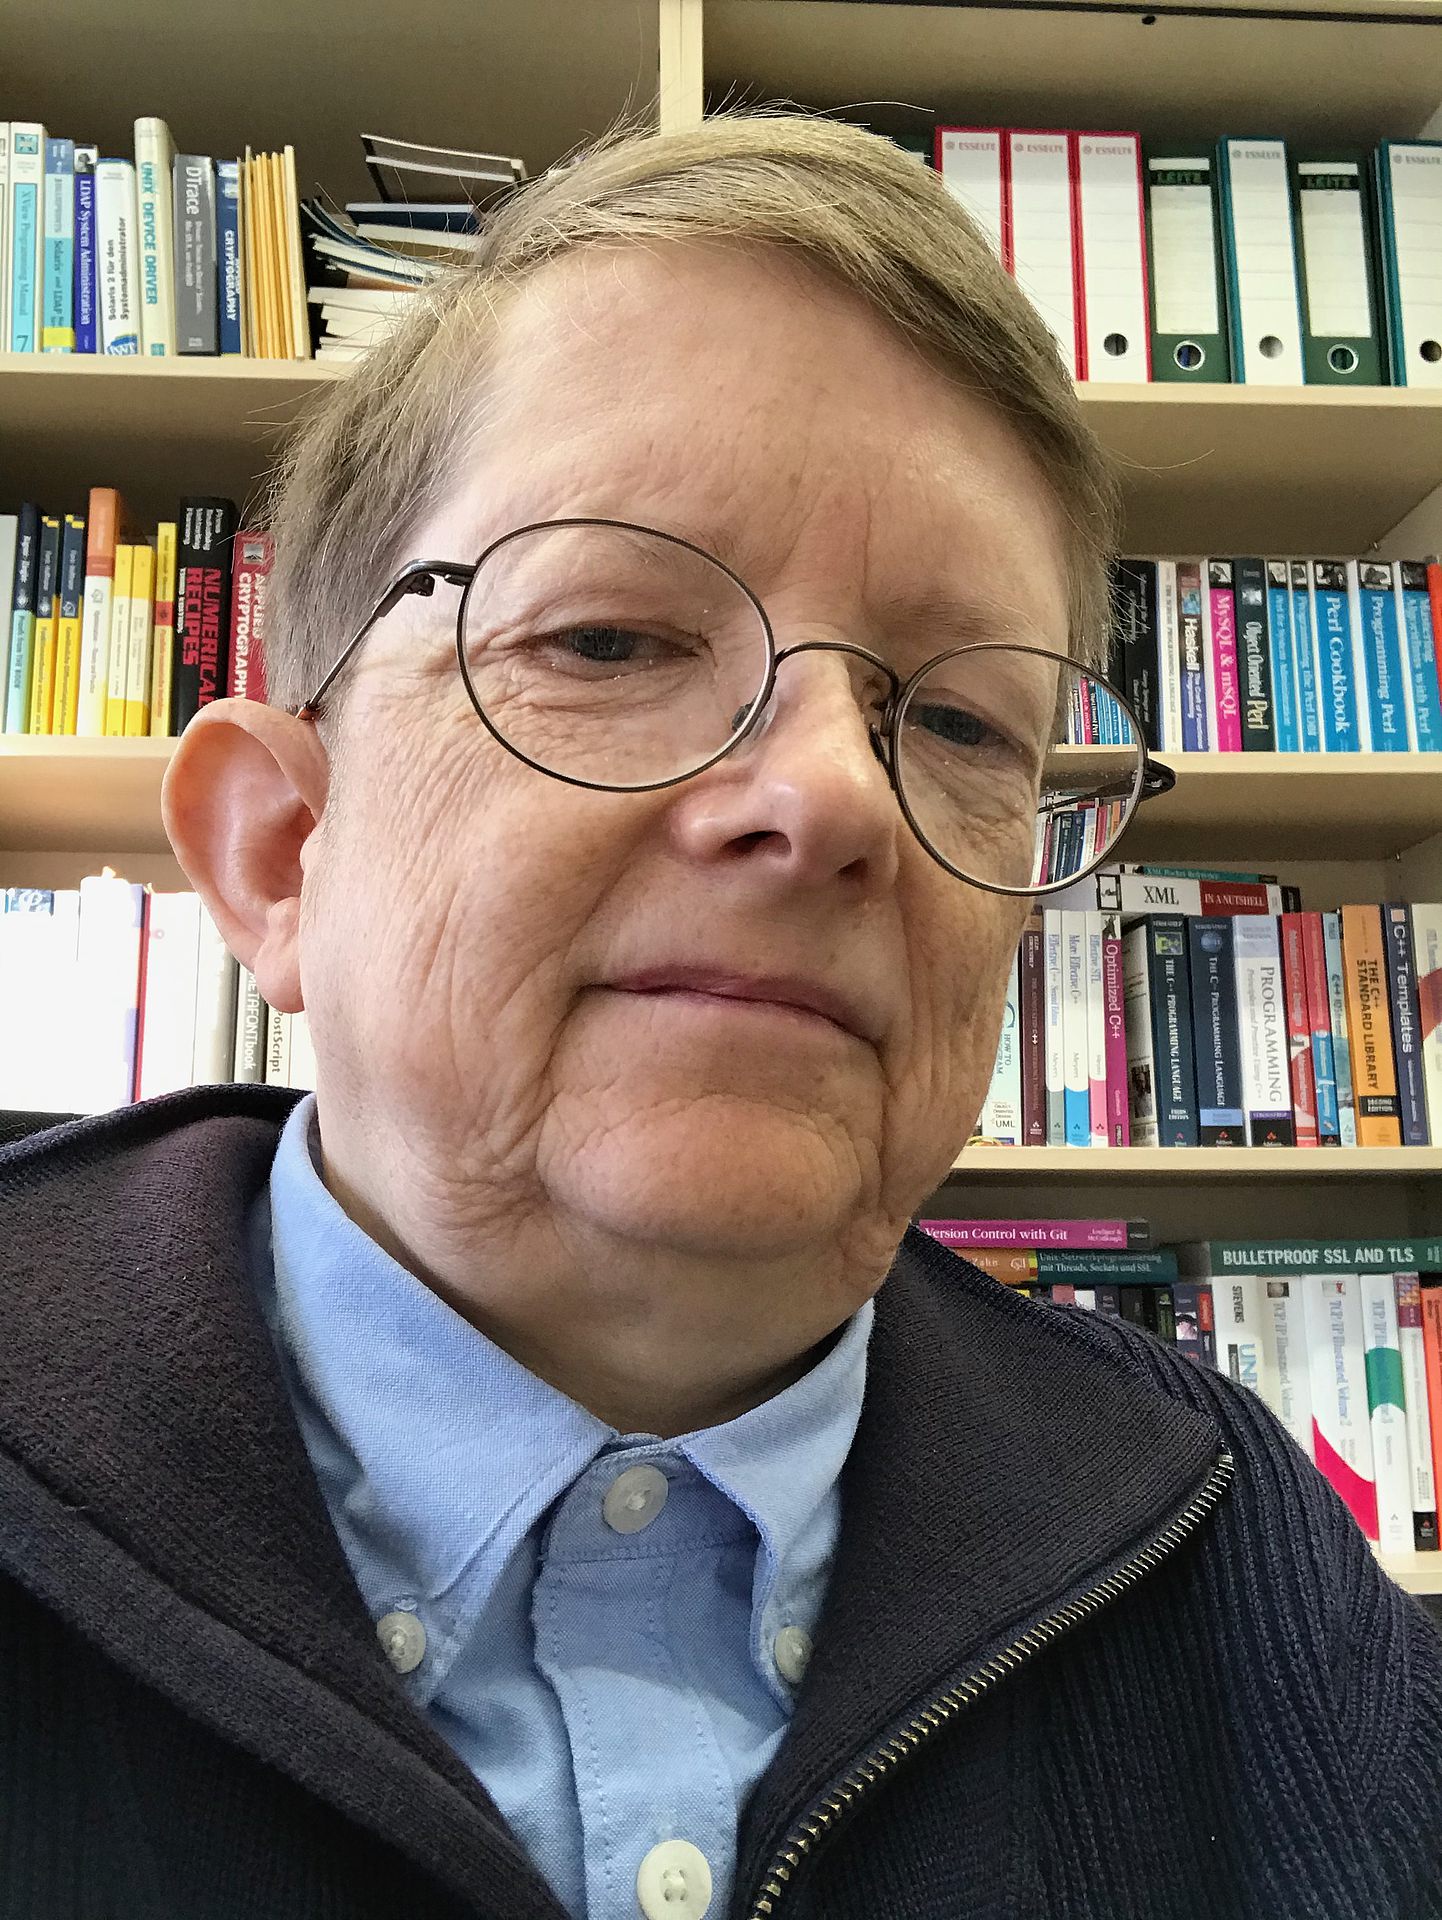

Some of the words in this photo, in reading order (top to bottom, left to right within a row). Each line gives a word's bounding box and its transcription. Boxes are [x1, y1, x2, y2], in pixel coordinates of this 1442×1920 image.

[958, 142, 996, 151] ESSELTE
[1026, 144, 1064, 154] ESSELTE
[1095, 146, 1132, 156] ESSELTE
[1244, 150, 1280, 160] ESSELTE
[1404, 155, 1440, 165] ESSELTE
[141, 162, 153, 194] UNIX
[186, 166, 202, 215] DTrace
[1157, 171, 1201, 185] LEITZ
[1305, 175, 1350, 188] LEITZ
[80, 180, 91, 208] LDAP
[79, 210, 90, 247] System
[143, 201, 156, 251] DEVICE
[54, 240, 63, 271] Solaris
[106, 261, 116, 275] für
[119, 217, 130, 320] Systemadministrator
[80, 248, 91, 325] Administration
[145, 255, 157, 305] DRIVER
[224, 230, 236, 321] CRYPTOGRAPHY
[19, 282, 29, 316] Manual
[53, 290, 62, 314] LDAP
[108, 286, 116, 321] Solaris
[17, 335, 29, 352] 7
[182, 567, 204, 665] RECIPES
[1214, 594, 1232, 650] MySQL
[1326, 597, 1343, 632] Perl
[198, 568, 222, 708] NUMERICAL
[233, 572, 253, 699] CRYPTOGRAPHY
[1184, 618, 1200, 672] Haskell
[1243, 621, 1263, 654] Object
[1371, 597, 1390, 700] Programming
[1220, 654, 1234, 667] &
[1246, 654, 1265, 698] Oriented
[1303, 670, 1312, 687] the
[1329, 637, 1350, 734] Cookbook
[1415, 672, 1427, 703] with
[1187, 672, 1195, 719] Programming
[1219, 671, 1237, 720] mSQL
[1304, 690, 1315, 712] Perl
[1247, 700, 1269, 730] Perl
[1380, 704, 1396, 734] Perl
[1417, 707, 1431, 734] Perl
[1142, 886, 1180, 906] XML
[1204, 893, 1214, 903] IN
[1215, 895, 1222, 904] A
[1223, 894, 1266, 907] NUTSHELL
[1048, 934, 1059, 967] Effective
[1069, 934, 1079, 955] More
[1089, 934, 1100, 967] Effective
[1393, 924, 1406, 957] C++
[1050, 968, 1060, 983] C++
[1069, 956, 1081, 989] Effective
[1090, 968, 1101, 984] STL
[1104, 943, 1121, 1012] Optimized
[1165, 959, 1175, 977] THE
[1208, 957, 1218, 974] THE
[1291, 970, 1300, 990] C++
[1368, 960, 1379, 983] THE
[1071, 990, 1081, 1005] C++
[1166, 977, 1175, 992] C++
[1331, 974, 1341, 996] C++
[1357, 959, 1373, 1031] STANDARD
[1369, 986, 1380, 1009] C++
[244, 972, 260, 1070] METAFONTbook
[1249, 1008, 1258, 1024] and
[1396, 962, 1413, 1053] Templates
[1108, 1014, 1121, 1039] C++
[1166, 993, 1178, 1058] PROGRAMMING
[1210, 991, 1223, 1059] PROGRAMMING
[1260, 966, 1282, 1103] PROGRAMMING
[269, 1011, 284, 1073] PostScript
[1004, 1034, 1012, 1051] HOW
[1250, 1025, 1261, 1057] Practice
[1004, 1054, 1012, 1067] TO
[1071, 1051, 1079, 1079] Meyers
[1364, 1033, 1378, 1090] LIBRARY
[1170, 1058, 1181, 1103] LANGUAGE
[1214, 1060, 1225, 1106] LANGUAGE
[995, 1120, 1016, 1128] UML
[924, 1227, 969, 1239] Version
[971, 1228, 1016, 1240] Control
[1019, 1228, 1047, 1240] with
[1049, 1229, 1068, 1241] Git
[1040, 1264, 1053, 1272] mit
[1055, 1263, 1089, 1273] Threads,
[1089, 1264, 1119, 1272] Sockets
[1120, 1264, 1136, 1272] und
[1136, 1264, 1152, 1272] SSL
[1223, 1249, 1319, 1265] BULLETPROOF
[1323, 1249, 1351, 1264] SSL
[1354, 1248, 1383, 1263] AND
[1386, 1247, 1415, 1263] TLS
[1232, 1285, 1244, 1323] STEVENS
[1337, 1386, 1349, 1419] Volume
